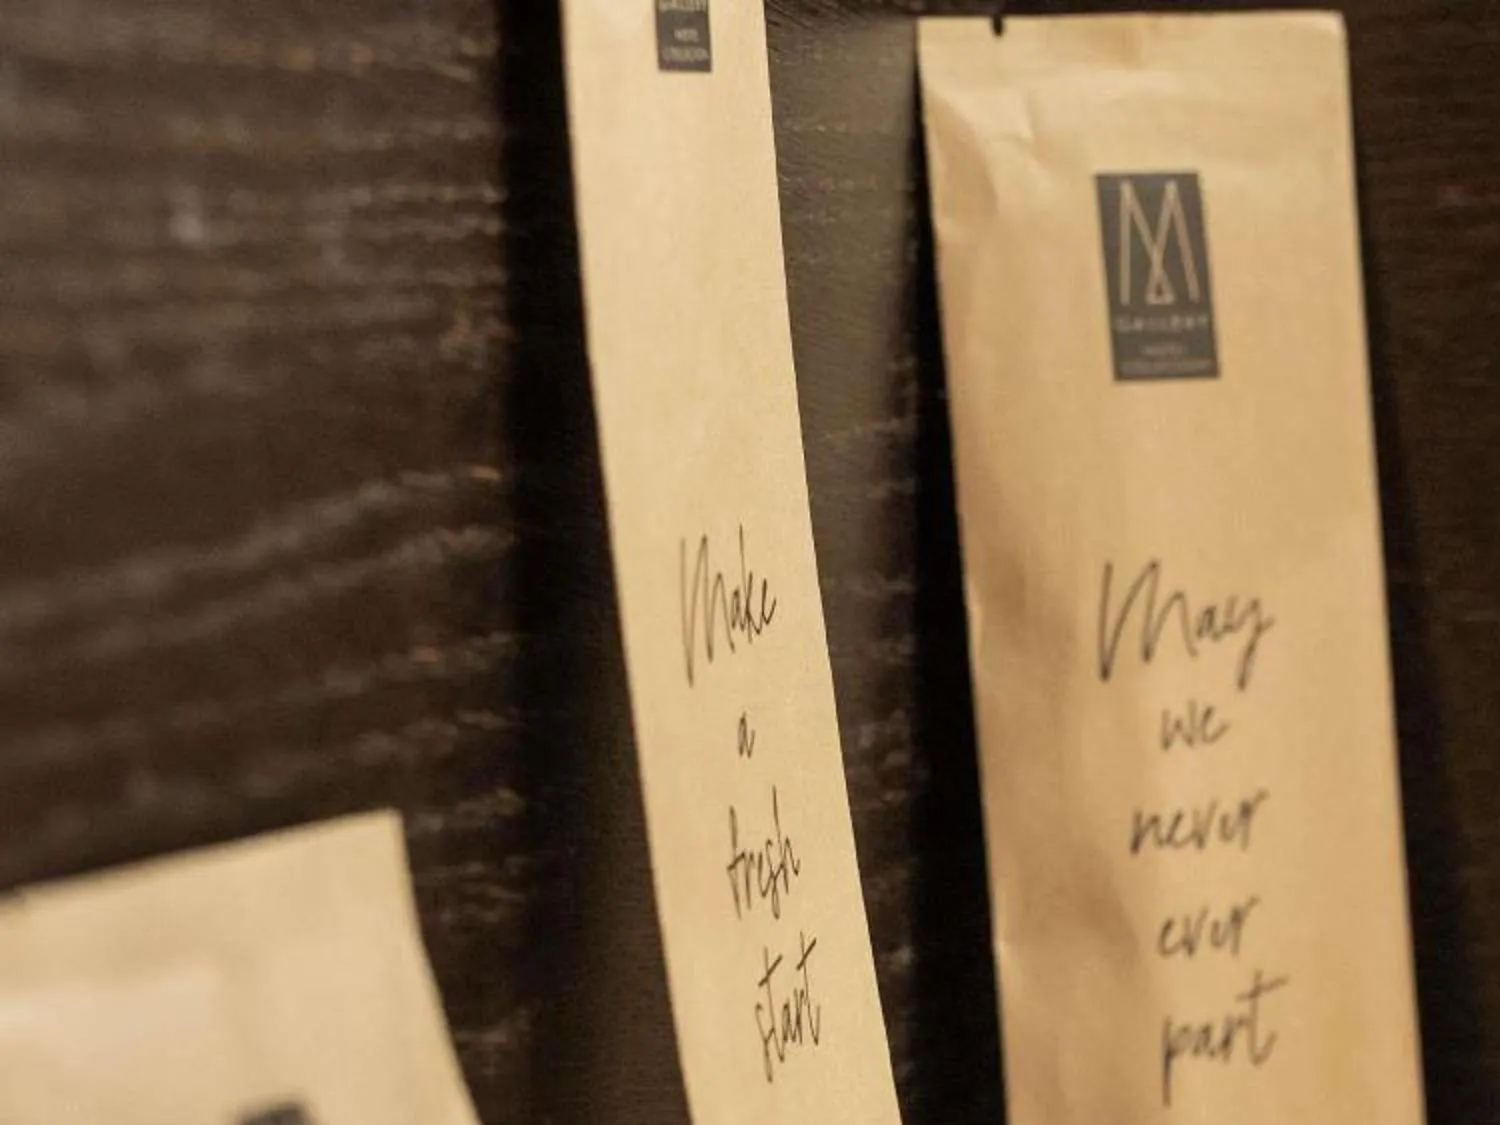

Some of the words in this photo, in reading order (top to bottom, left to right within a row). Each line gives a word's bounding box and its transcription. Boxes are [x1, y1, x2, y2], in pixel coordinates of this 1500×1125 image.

[680, 523, 777, 688] Make
[1098, 559, 1275, 691] May
[737, 710, 757, 760] a
[1159, 700, 1231, 752] we
[726, 783, 801, 920] fresh
[1130, 788, 1270, 856] never
[1157, 896, 1262, 957] ever
[754, 931, 820, 1083] start
[1159, 970, 1290, 1107] part
